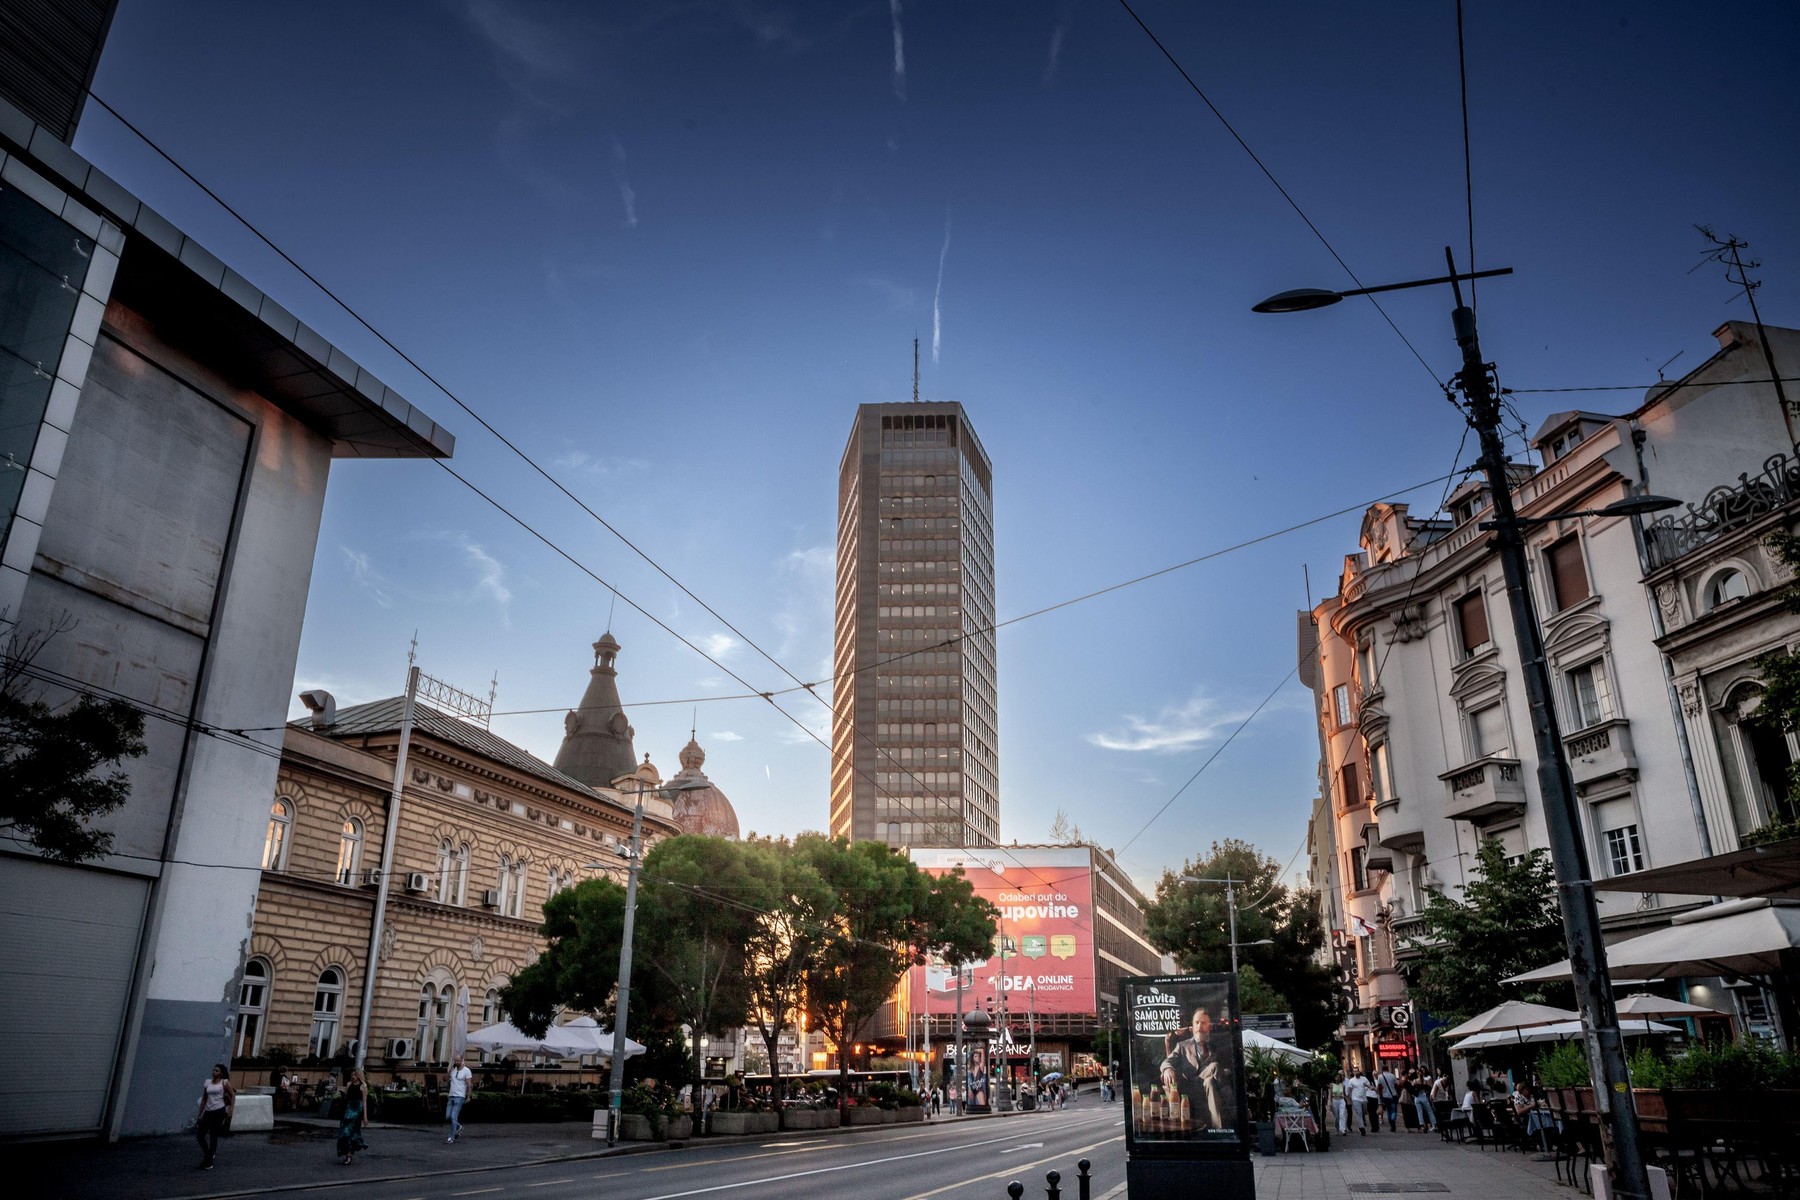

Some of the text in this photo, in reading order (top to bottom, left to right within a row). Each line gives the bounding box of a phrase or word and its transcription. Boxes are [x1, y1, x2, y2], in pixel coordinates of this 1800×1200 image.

[998, 892, 1067, 903] Odaberi put do
[998, 902, 1079, 922] upovine
[1037, 975, 1074, 984] ONLINE
[1134, 1010, 1158, 1021] SAMO
[1135, 1022, 1142, 1031] &
[1143, 1020, 1164, 1031] NIŠTA
